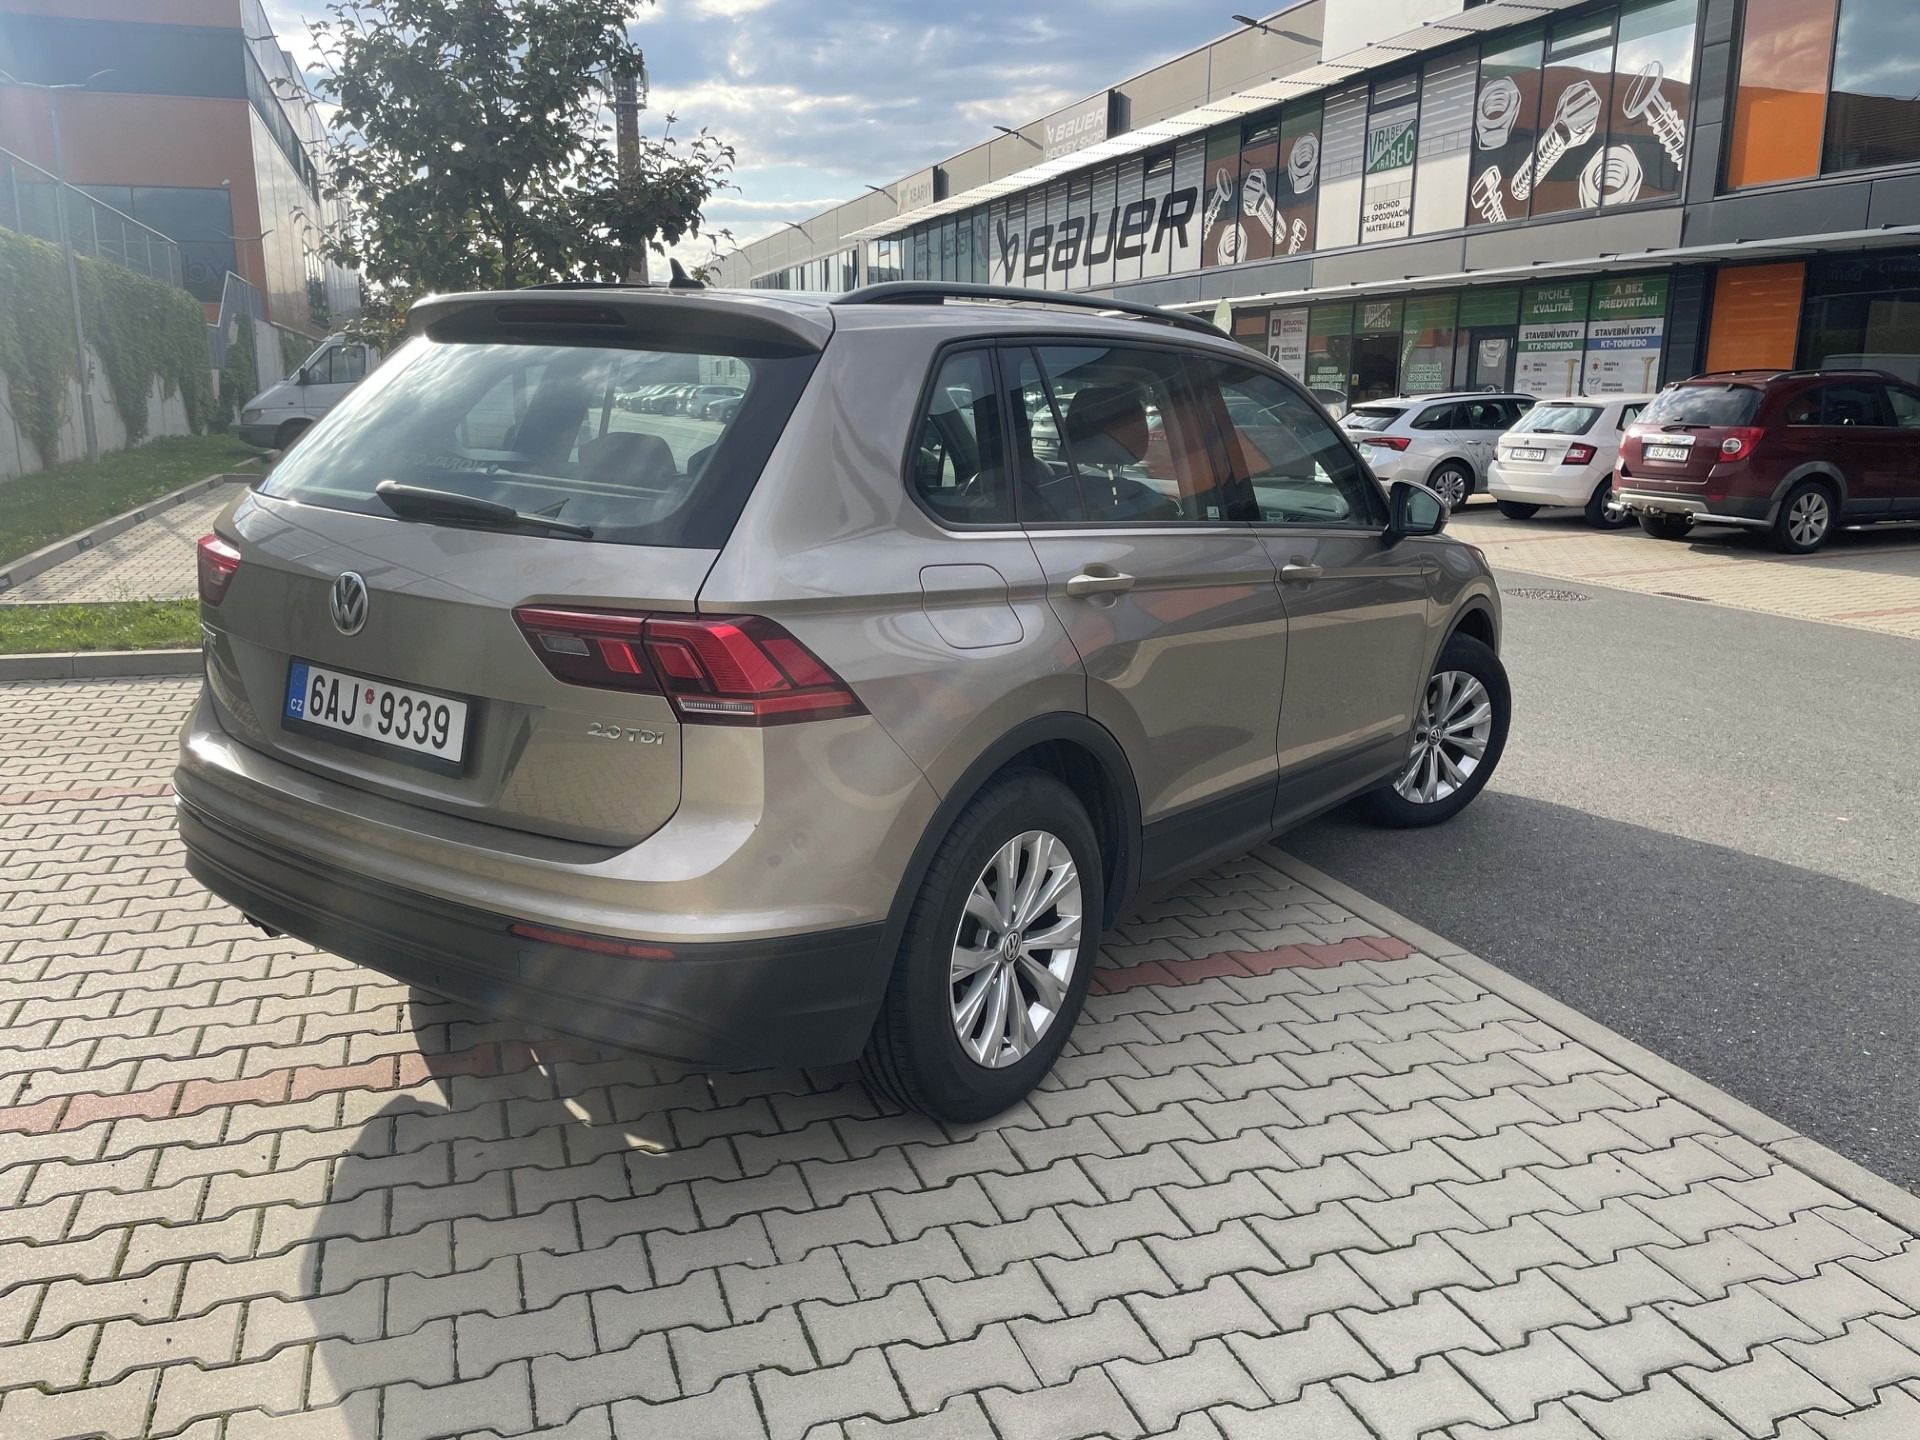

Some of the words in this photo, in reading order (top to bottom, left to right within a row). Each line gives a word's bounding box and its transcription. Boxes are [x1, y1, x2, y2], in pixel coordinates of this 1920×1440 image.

[1373, 200, 1400, 211] OBCHOD
[1366, 219, 1405, 233] MATERIÁLEM
[1614, 284, 1622, 295] A
[1625, 282, 1643, 294] BEZ
[1525, 328, 1556, 340] STAVEBNÍ
[1556, 329, 1579, 338] VRUTY
[1595, 324, 1630, 337] STAVEBNÍ
[1630, 326, 1656, 335] VRUTY
[1527, 341, 1573, 350] KTX-TORPEDO
[1600, 338, 1647, 348] KT-TORPEDO
[290, 698, 303, 712] CZ
[309, 674, 359, 725] 6AJ
[377, 691, 450, 749] 9339
[625, 727, 664, 745] TDI
